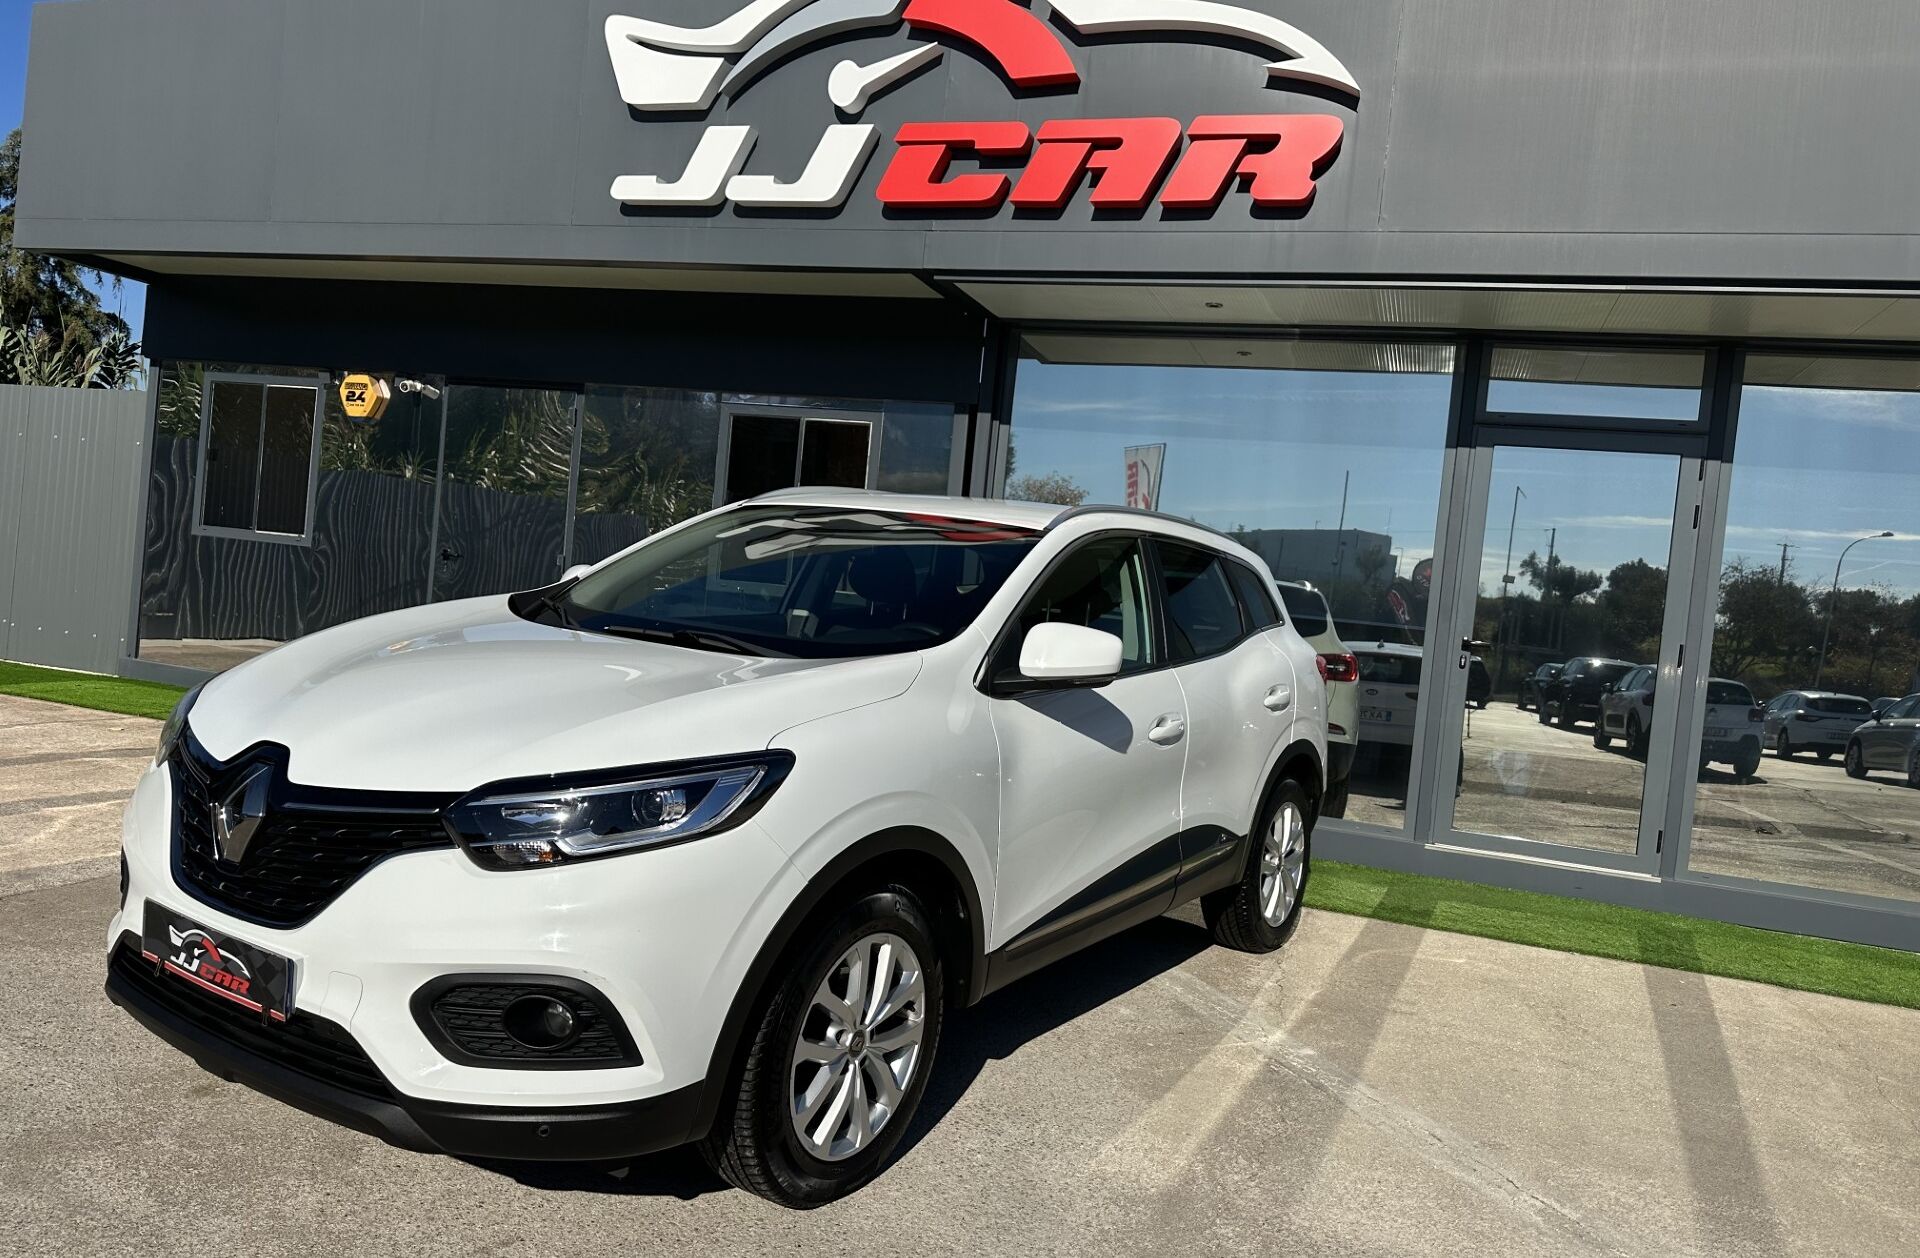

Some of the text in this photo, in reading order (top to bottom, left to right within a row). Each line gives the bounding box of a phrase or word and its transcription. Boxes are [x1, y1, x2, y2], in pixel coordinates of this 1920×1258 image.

[875, 114, 1343, 208] CAR
[345, 390, 365, 402] 24
[200, 964, 250, 993] CAR
